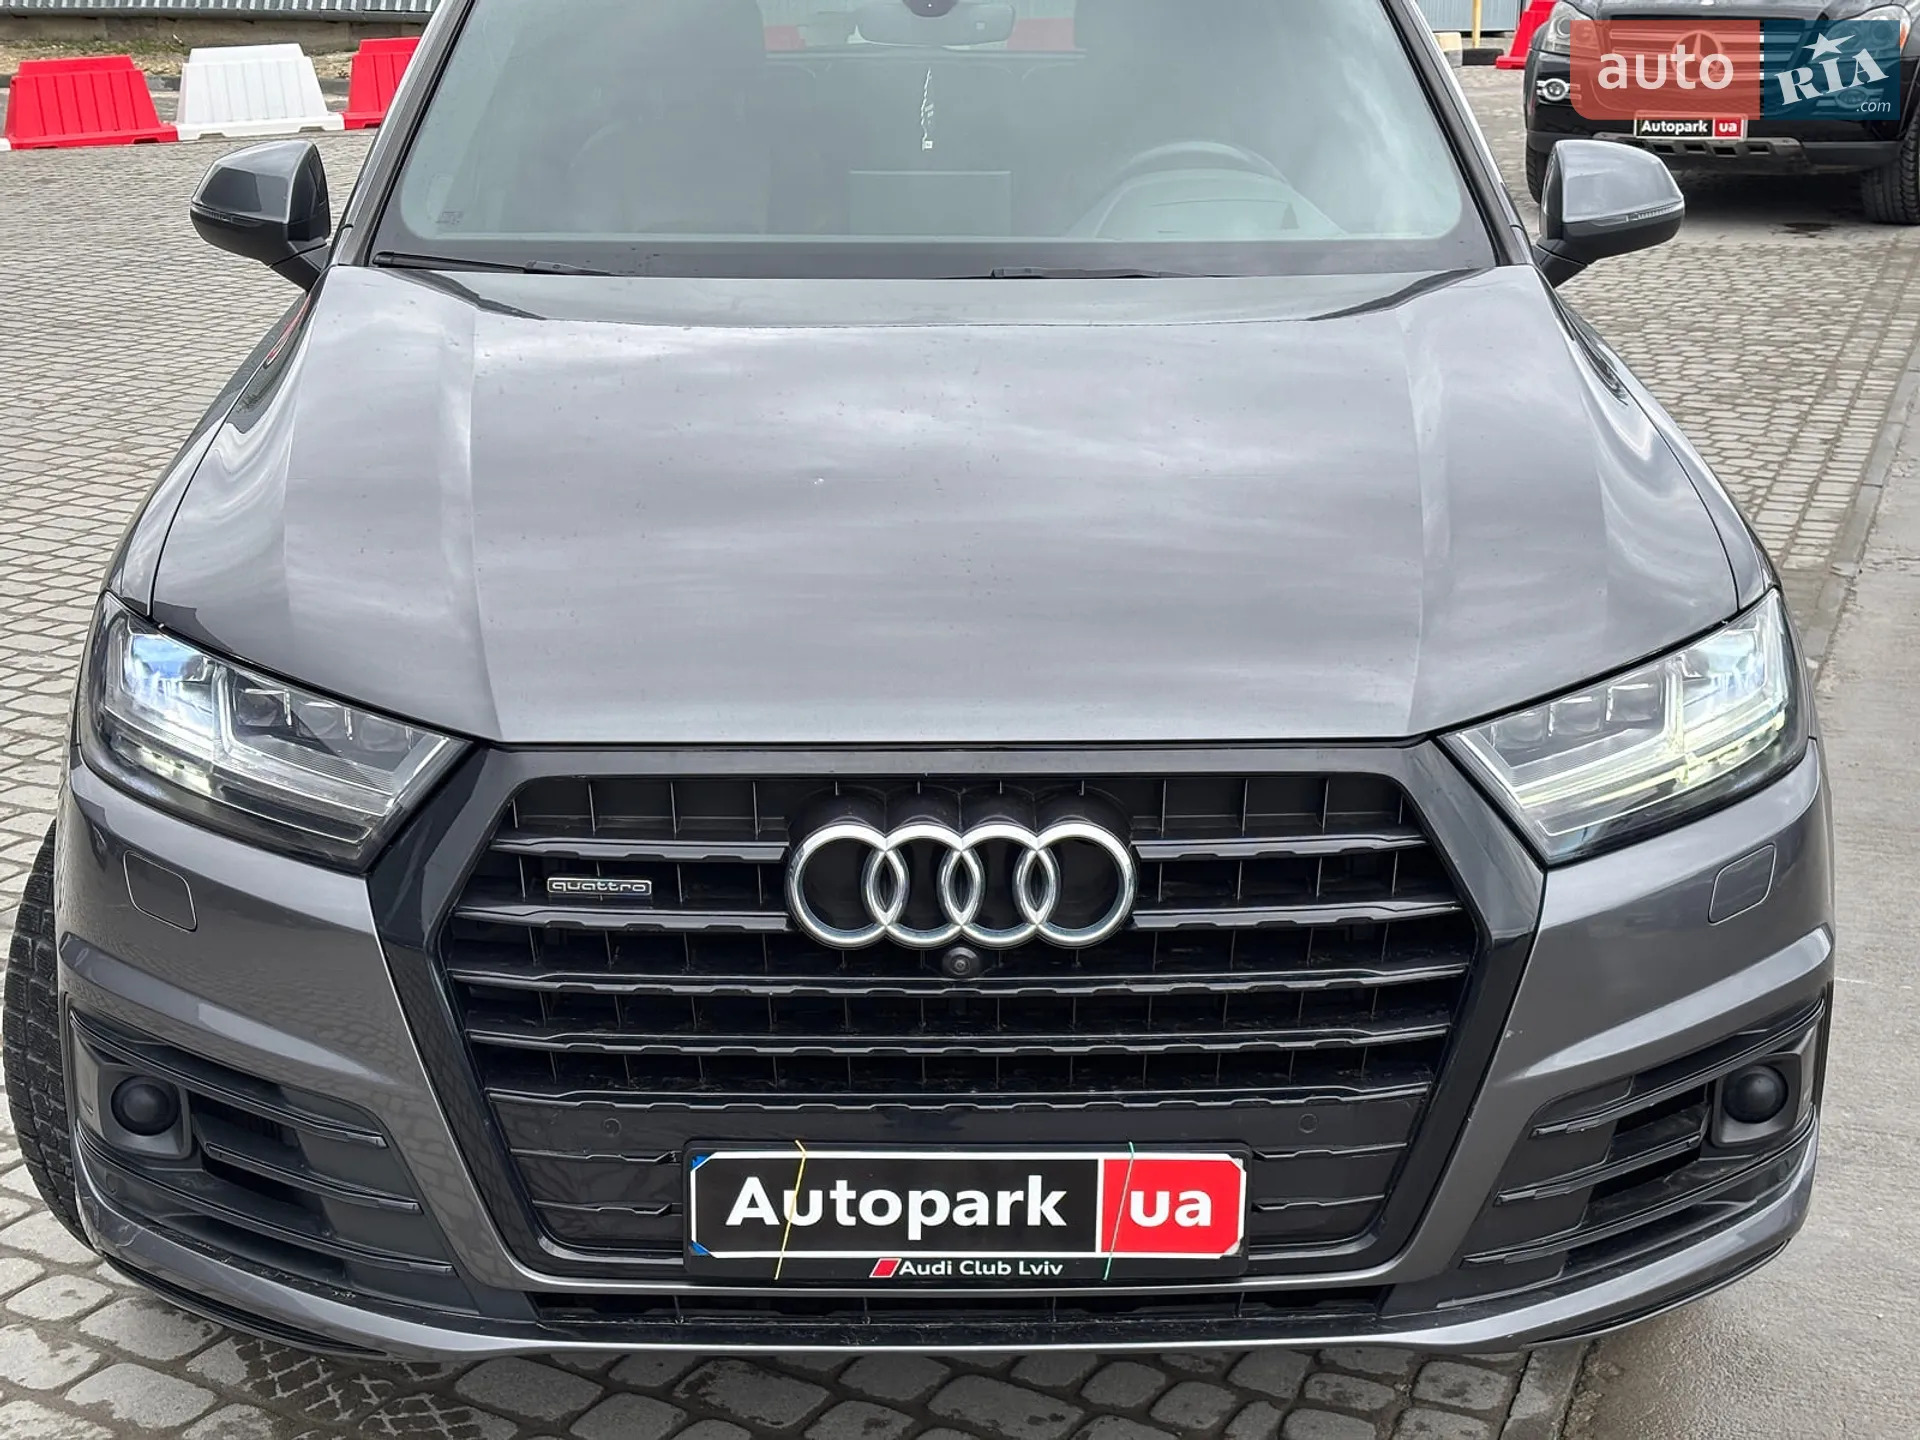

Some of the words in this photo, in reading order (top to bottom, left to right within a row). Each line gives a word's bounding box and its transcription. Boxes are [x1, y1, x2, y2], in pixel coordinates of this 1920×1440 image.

[1641, 120, 1708, 135] Autopark
[1719, 122, 1738, 132] ua
[552, 881, 646, 892] quattro
[725, 1174, 1067, 1241] Autopark
[1129, 1189, 1213, 1227] ua
[899, 1260, 952, 1275] Audi
[959, 1260, 1012, 1275] Club
[1018, 1260, 1064, 1275] Lviv
